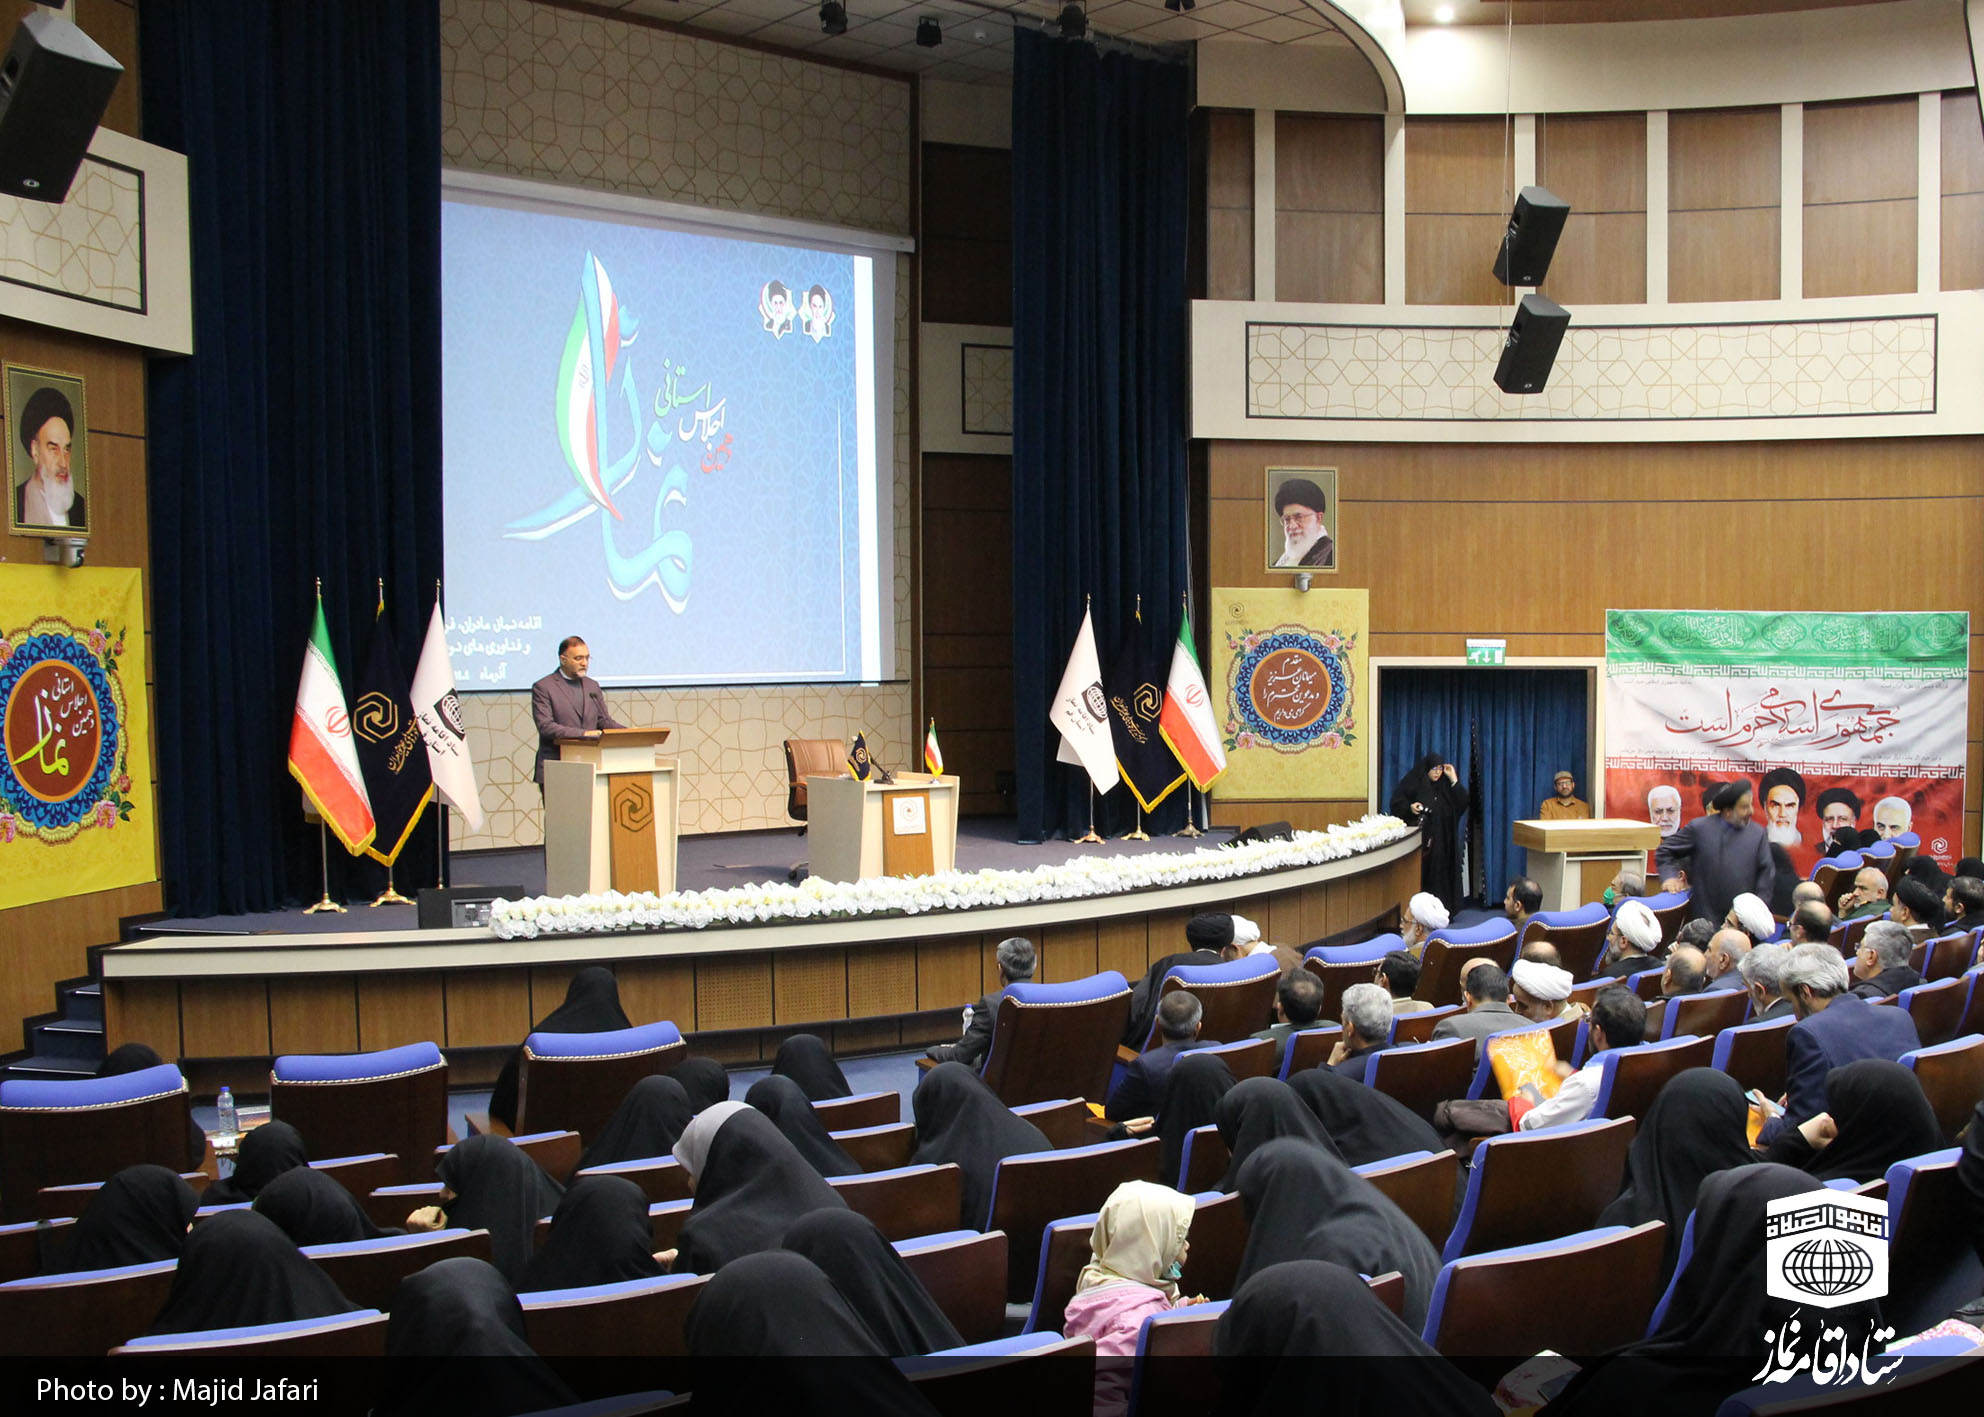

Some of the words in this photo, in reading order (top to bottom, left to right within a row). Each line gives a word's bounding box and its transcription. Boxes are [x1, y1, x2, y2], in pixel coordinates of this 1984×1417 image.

[654, 358, 712, 417] استانی
[502, 249, 693, 615] نماز
[678, 397, 727, 451] اجلاس
[51, 672, 75, 701] استانی
[1267, 666, 1303, 687] عزیز
[1282, 654, 1303, 675] مقدم
[60, 693, 88, 719] اجلاس
[72, 709, 95, 737] دهمین
[1665, 686, 1733, 734] است
[1760, 686, 1820, 736] اسلامی
[1803, 689, 1901, 751] جمهوری
[10, 688, 70, 776] نماز
[1701, 715, 1779, 748] حرم
